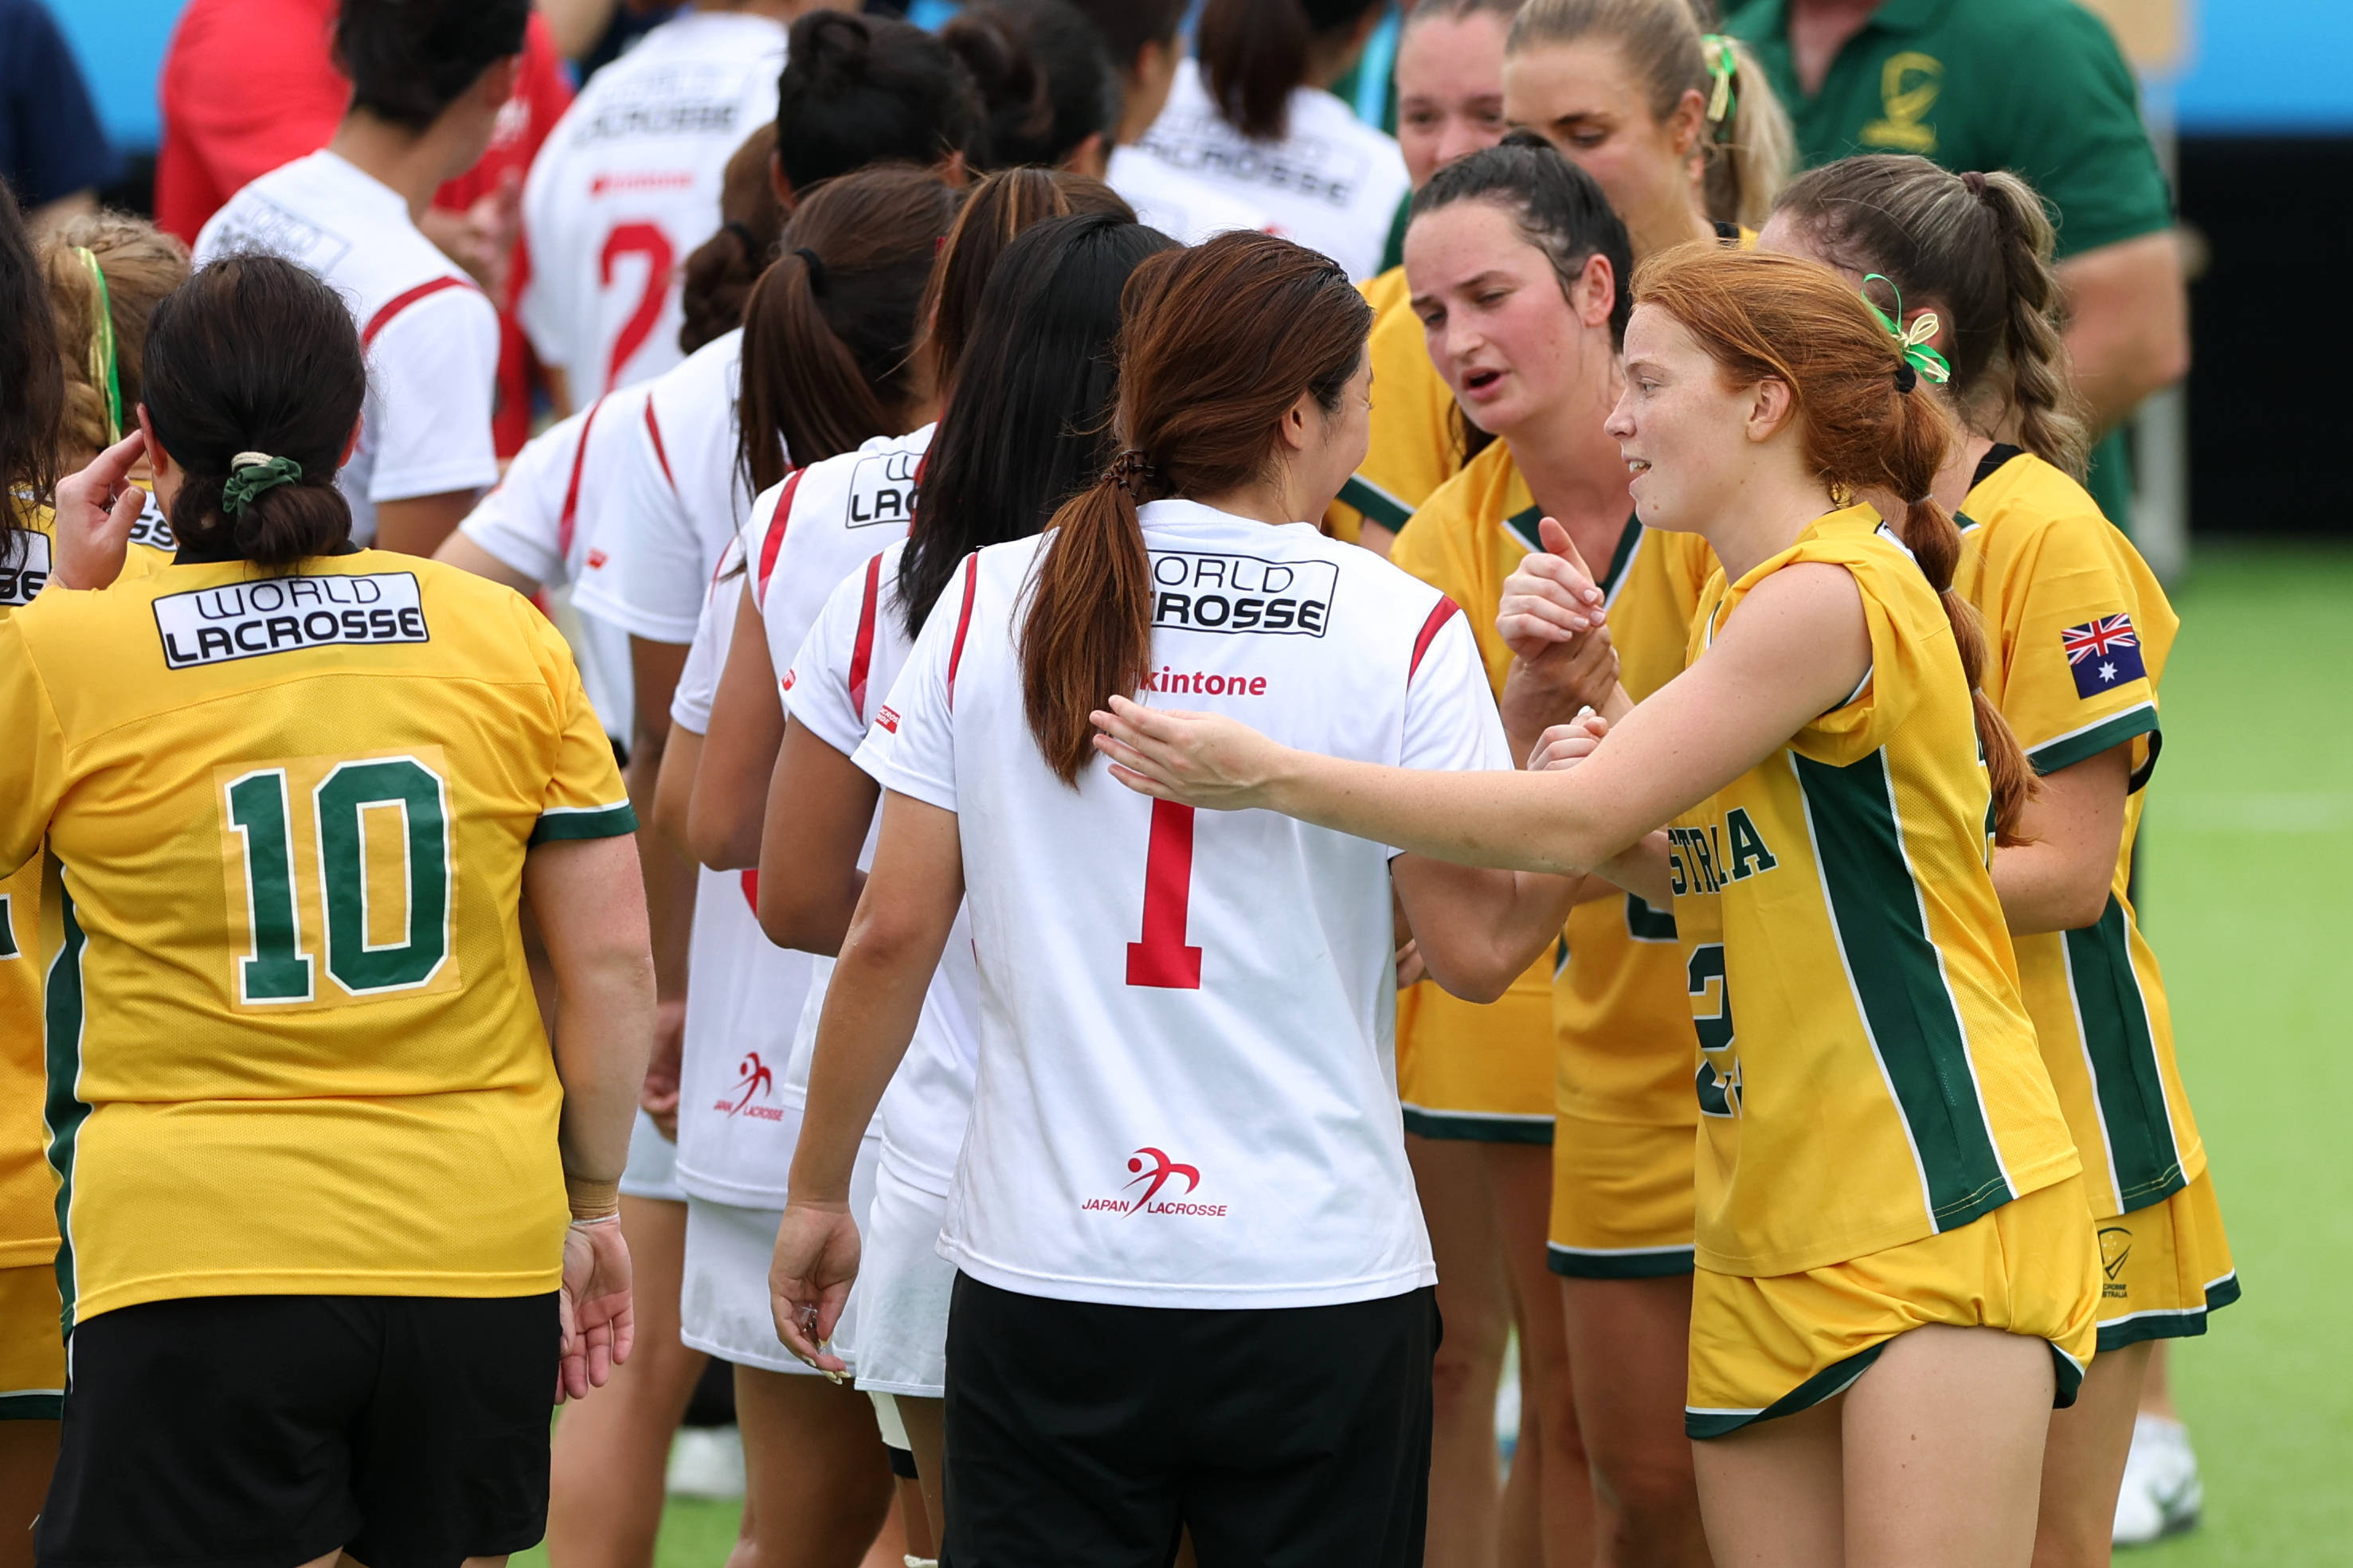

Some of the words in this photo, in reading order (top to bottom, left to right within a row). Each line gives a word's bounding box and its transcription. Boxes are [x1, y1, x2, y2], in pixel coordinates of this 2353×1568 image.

[1154, 556, 1294, 593] ORLD
[195, 579, 381, 620] WORLD
[1150, 591, 1326, 632] ROSSE
[166, 608, 425, 662] LACROSSE
[1140, 666, 1267, 695] kintone
[224, 755, 451, 1005] 10
[1082, 1198, 1130, 1212] JAPAN
[1147, 1202, 1227, 1216] LACROSSE
